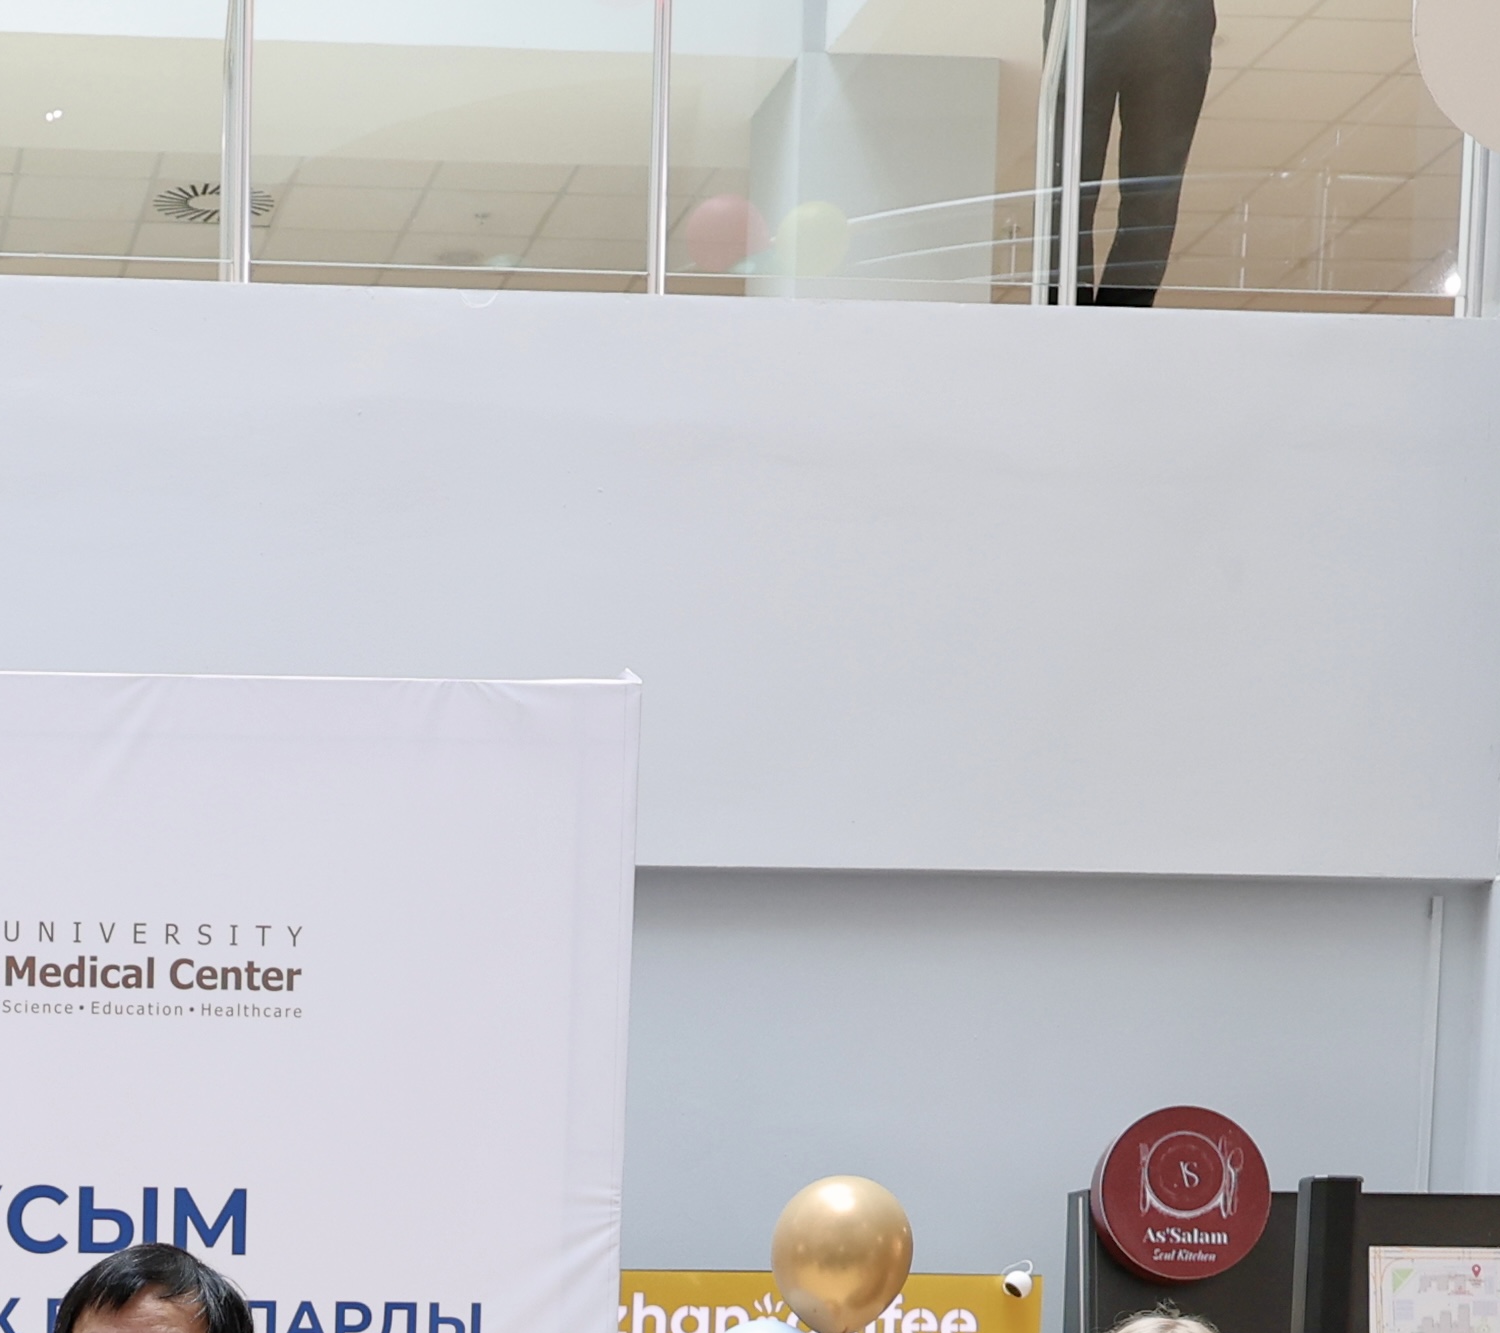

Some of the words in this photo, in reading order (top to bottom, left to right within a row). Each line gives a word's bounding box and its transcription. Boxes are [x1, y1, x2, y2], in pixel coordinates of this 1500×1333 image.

[4, 920, 303, 947] UNIVERSITY
[4, 955, 155, 989] Medical
[169, 958, 303, 991] Center
[2, 1000, 74, 1015] Science
[91, 1001, 183, 1017] Education
[201, 1003, 302, 1019] Healthcare
[1143, 1227, 1228, 1245] As'Salam
[1177, 1249, 1216, 1262] Kitchen
